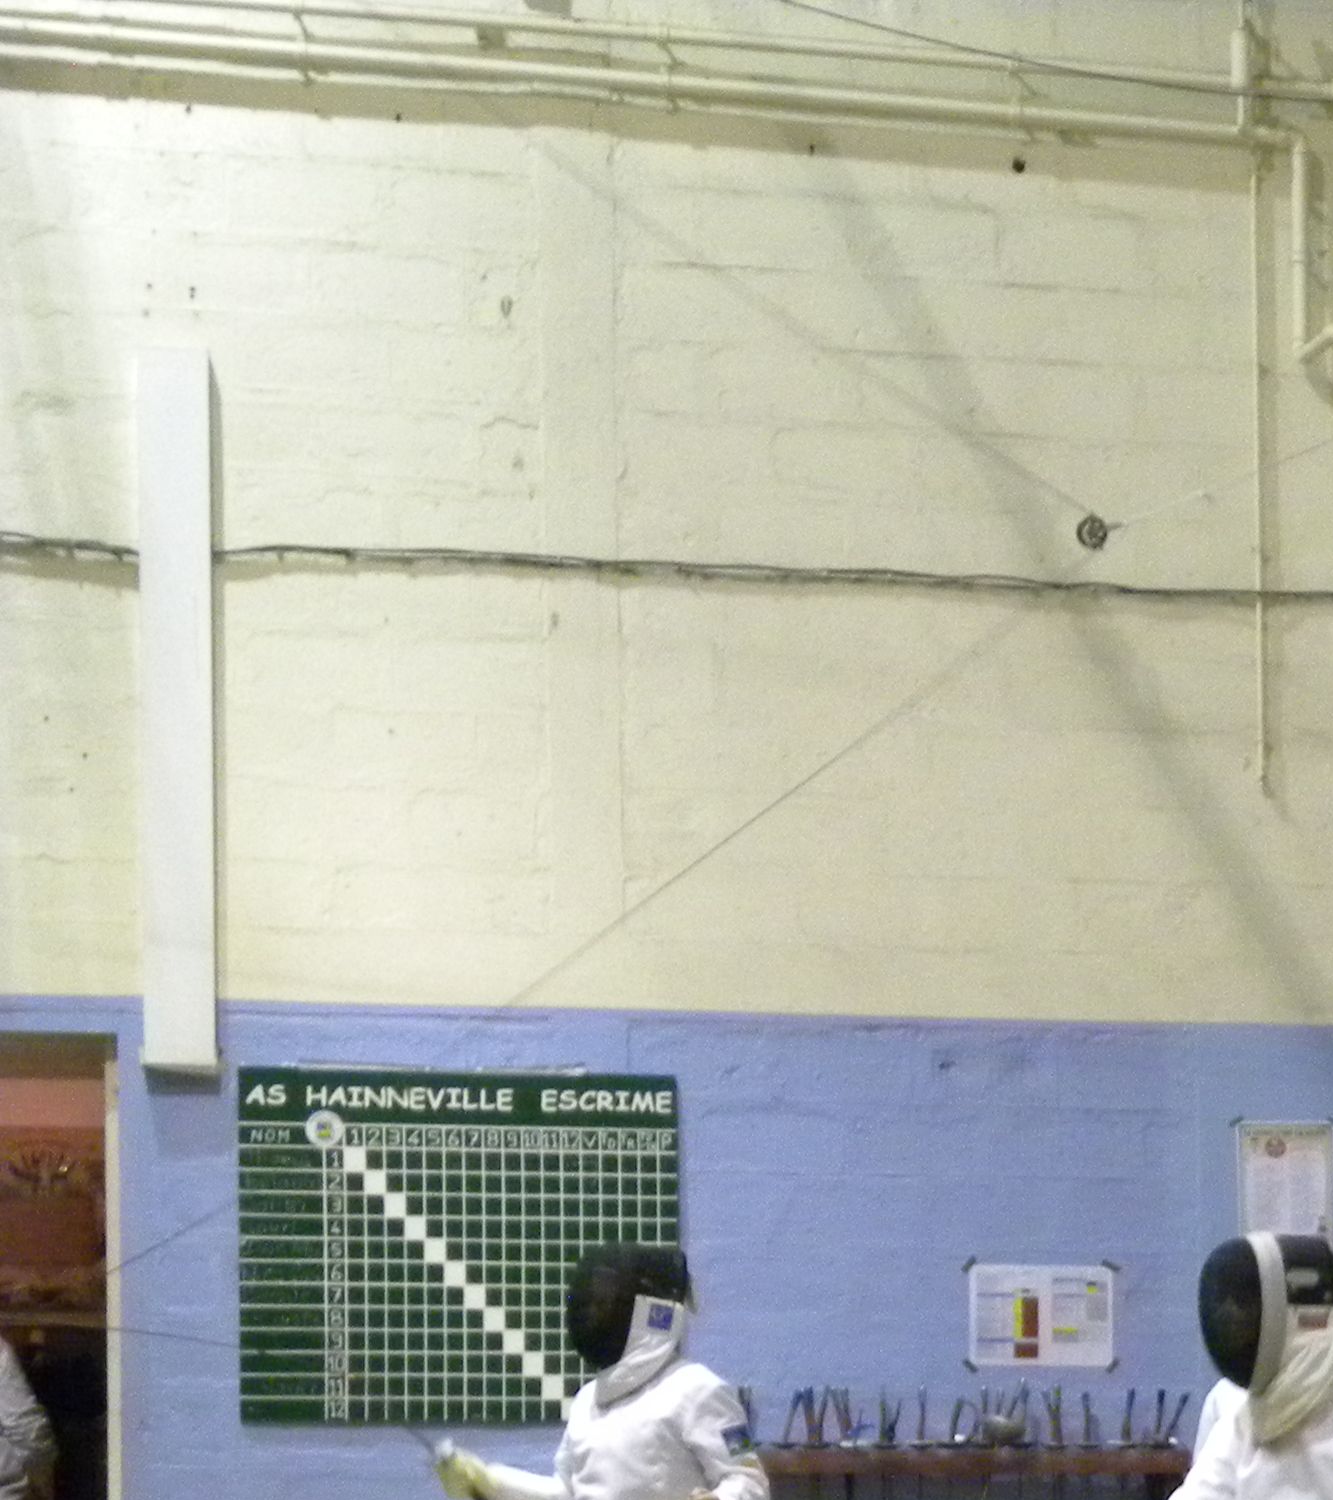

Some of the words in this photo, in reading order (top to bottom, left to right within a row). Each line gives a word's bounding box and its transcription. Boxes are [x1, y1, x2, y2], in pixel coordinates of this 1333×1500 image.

[246, 1084, 287, 1106] AS
[305, 1085, 514, 1111] HAINNEVILLE
[540, 1088, 673, 1114] ESCRIME
[249, 1127, 291, 1144] NOM
[350, 1129, 361, 1145] 1
[368, 1129, 380, 1146] 2
[388, 1129, 400, 1146] 3
[407, 1129, 420, 1145] 4
[429, 1129, 440, 1146] 5
[447, 1130, 460, 1147] 6
[468, 1130, 480, 1145] 7
[486, 1131, 498, 1146] 8
[506, 1131, 518, 1146] 9
[524, 1131, 541, 1148] 10
[543, 1131, 558, 1148] 11
[561, 1131, 580, 1148] 12
